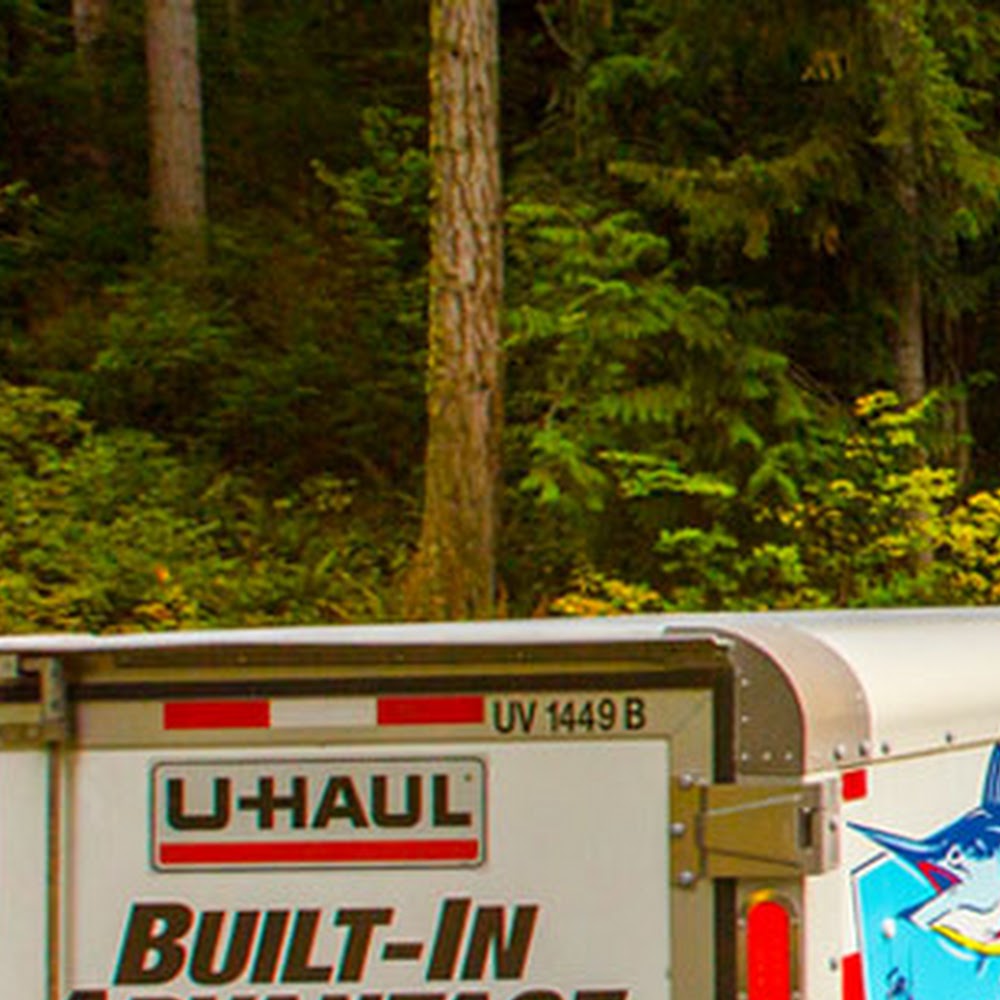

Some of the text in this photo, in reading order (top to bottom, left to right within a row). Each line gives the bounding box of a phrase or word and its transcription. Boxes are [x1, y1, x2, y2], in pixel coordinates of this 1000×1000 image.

[494, 697, 647, 733] UV 1449 B
[165, 774, 473, 832] U-HAUL
[114, 897, 539, 986] BUILT-IN
